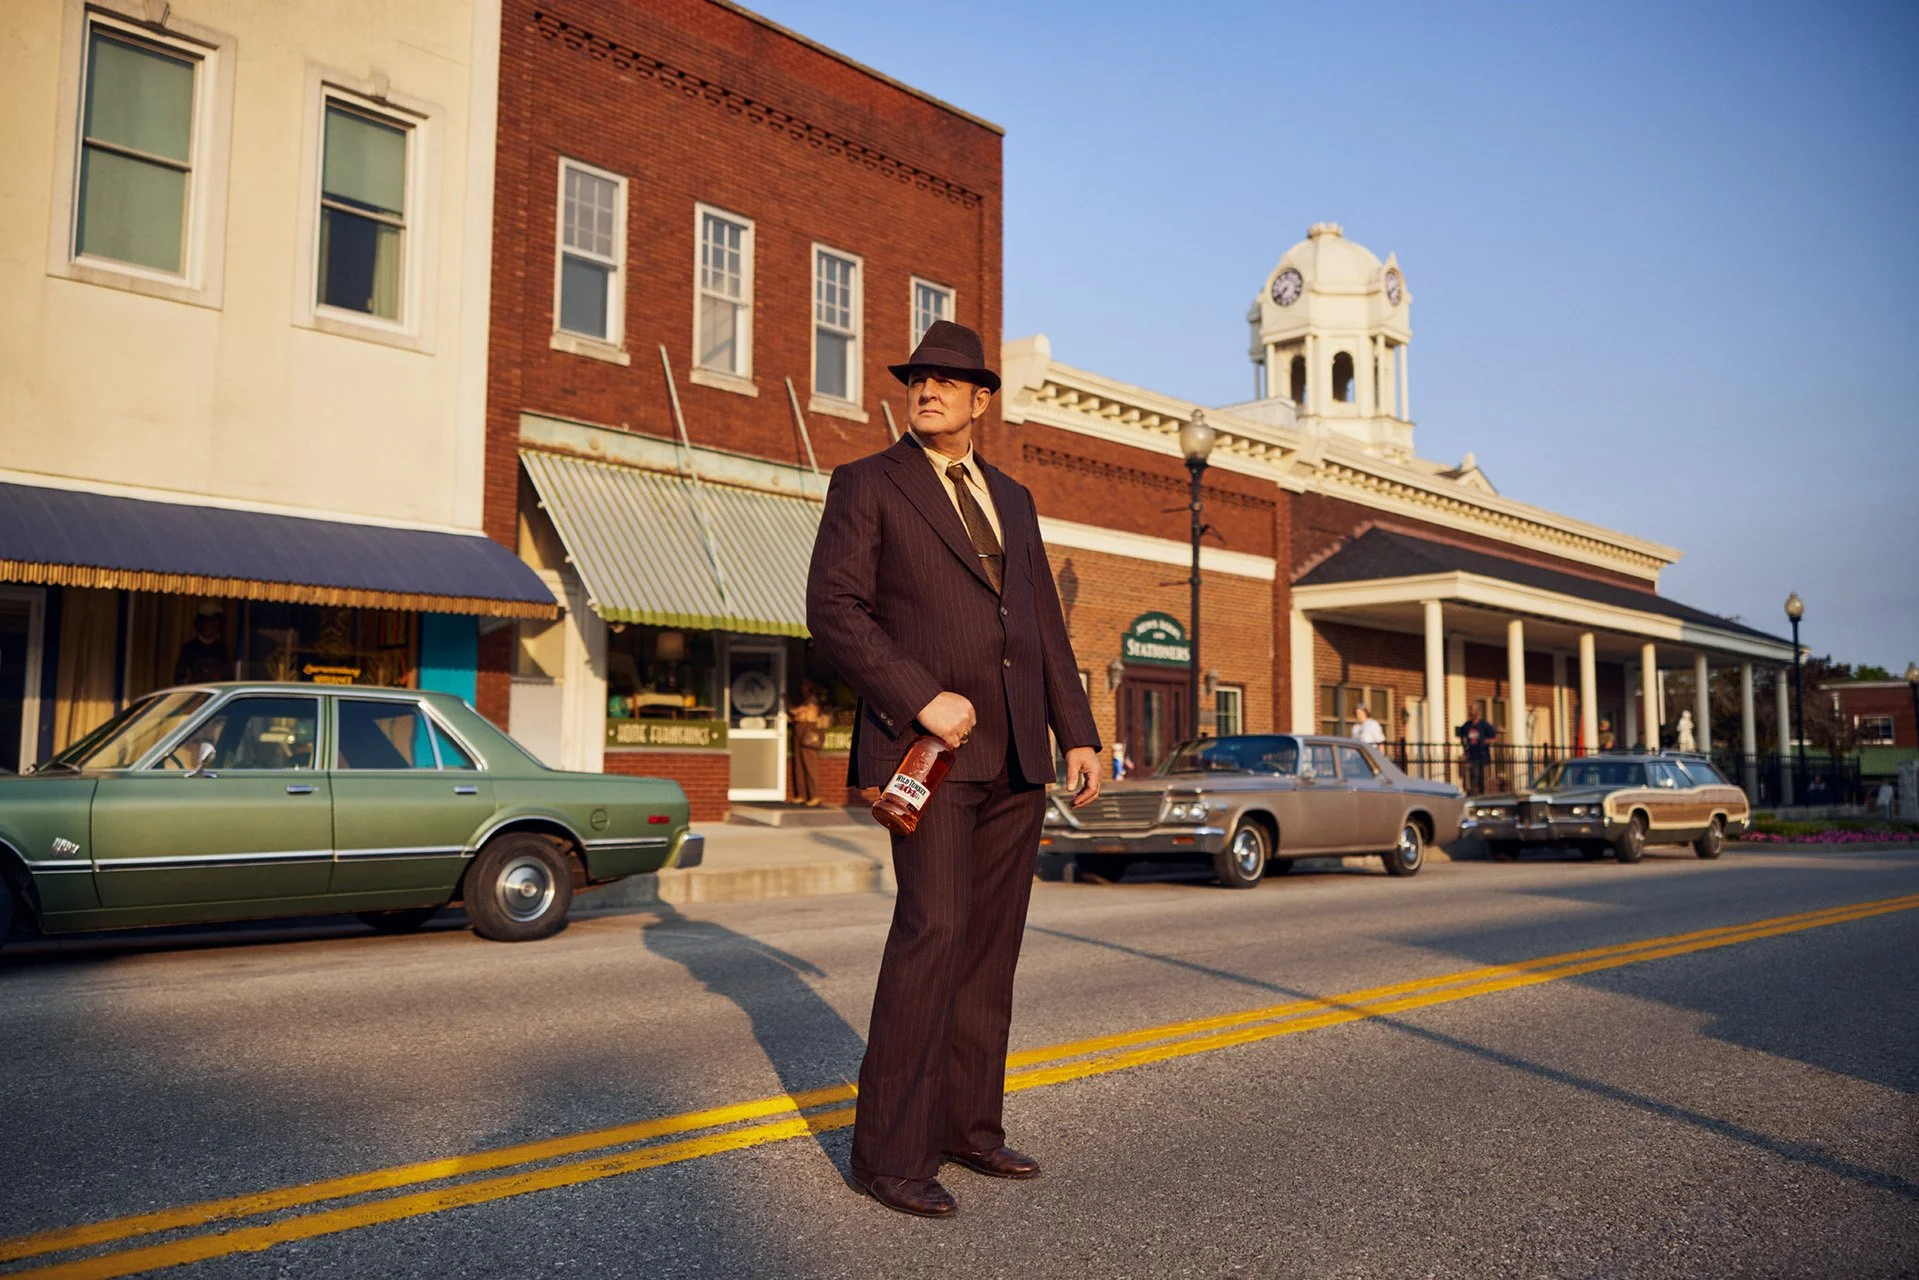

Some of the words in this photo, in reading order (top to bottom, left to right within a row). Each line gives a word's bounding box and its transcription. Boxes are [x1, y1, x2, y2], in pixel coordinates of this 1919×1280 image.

[1126, 639, 1190, 661] STATIONERS
[617, 723, 647, 743] HOME
[650, 725, 710, 745] FURNISHINGS
[896, 775, 910, 785] WILD
[909, 779, 926, 796] TURKEY
[899, 784, 916, 797] 101
